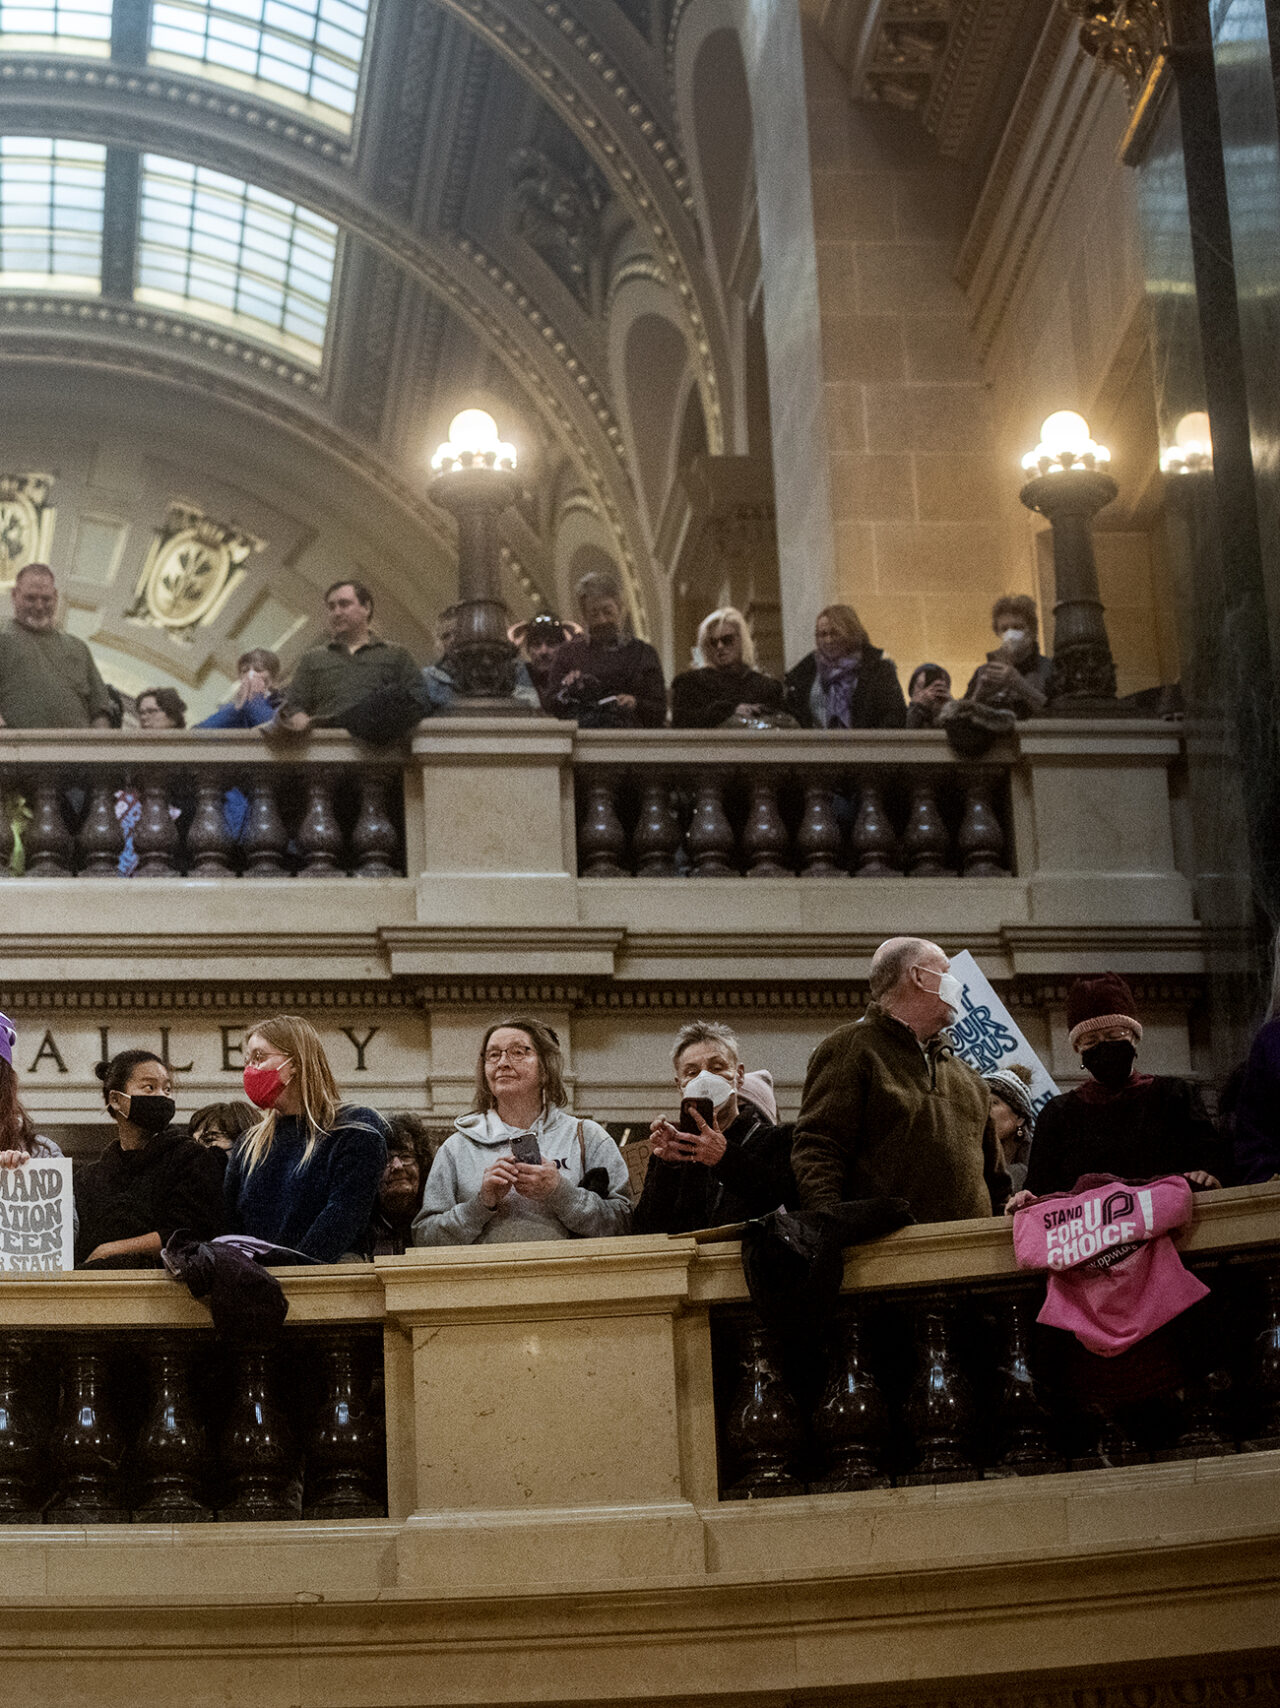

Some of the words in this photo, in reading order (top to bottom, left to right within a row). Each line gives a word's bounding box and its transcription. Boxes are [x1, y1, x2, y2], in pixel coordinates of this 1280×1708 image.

[948, 1005, 1009, 1053] OUR
[28, 1025, 379, 1073] ALEY
[1043, 1205, 1083, 1229] STAND
[1046, 1218, 1084, 1249] FOR
[9, 1250, 63, 1271] STATE
[1047, 1222, 1137, 1270] CHOICE
